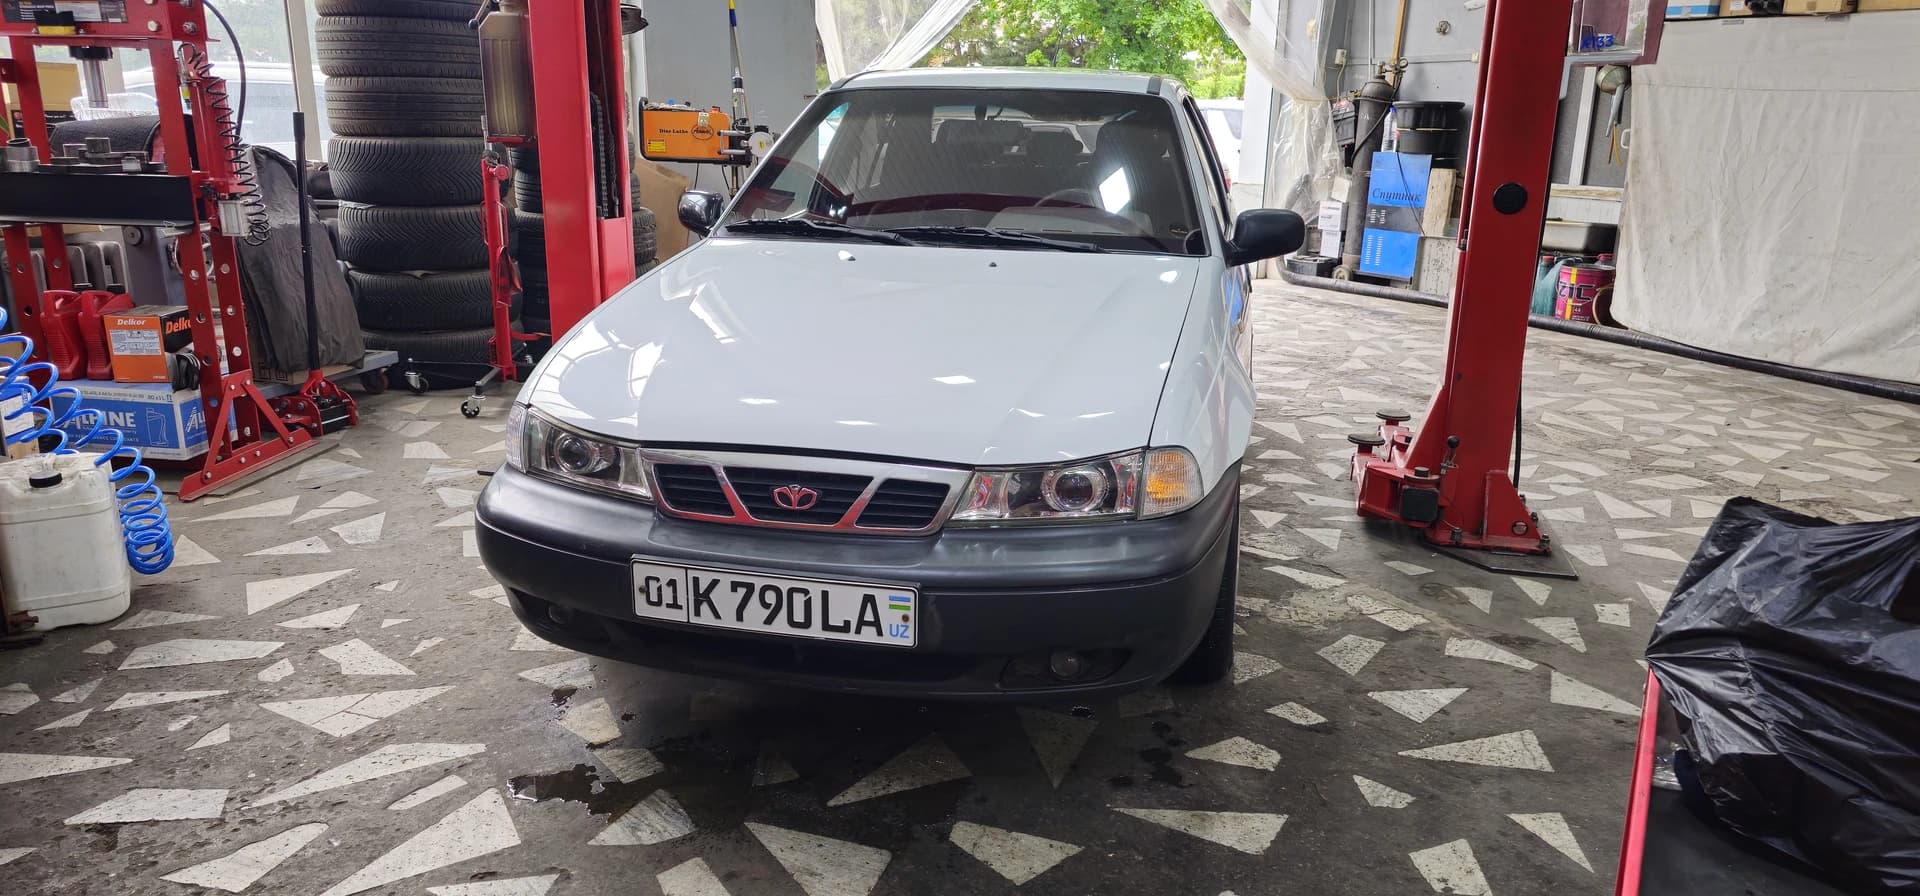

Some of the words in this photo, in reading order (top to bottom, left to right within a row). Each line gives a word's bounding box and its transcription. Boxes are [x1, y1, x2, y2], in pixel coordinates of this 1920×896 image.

[1372, 187, 1422, 203] Спутник
[1558, 281, 1595, 301] ZIC
[117, 318, 146, 326] Delkor
[644, 575, 683, 610] 01
[889, 623, 910, 639] UZ
